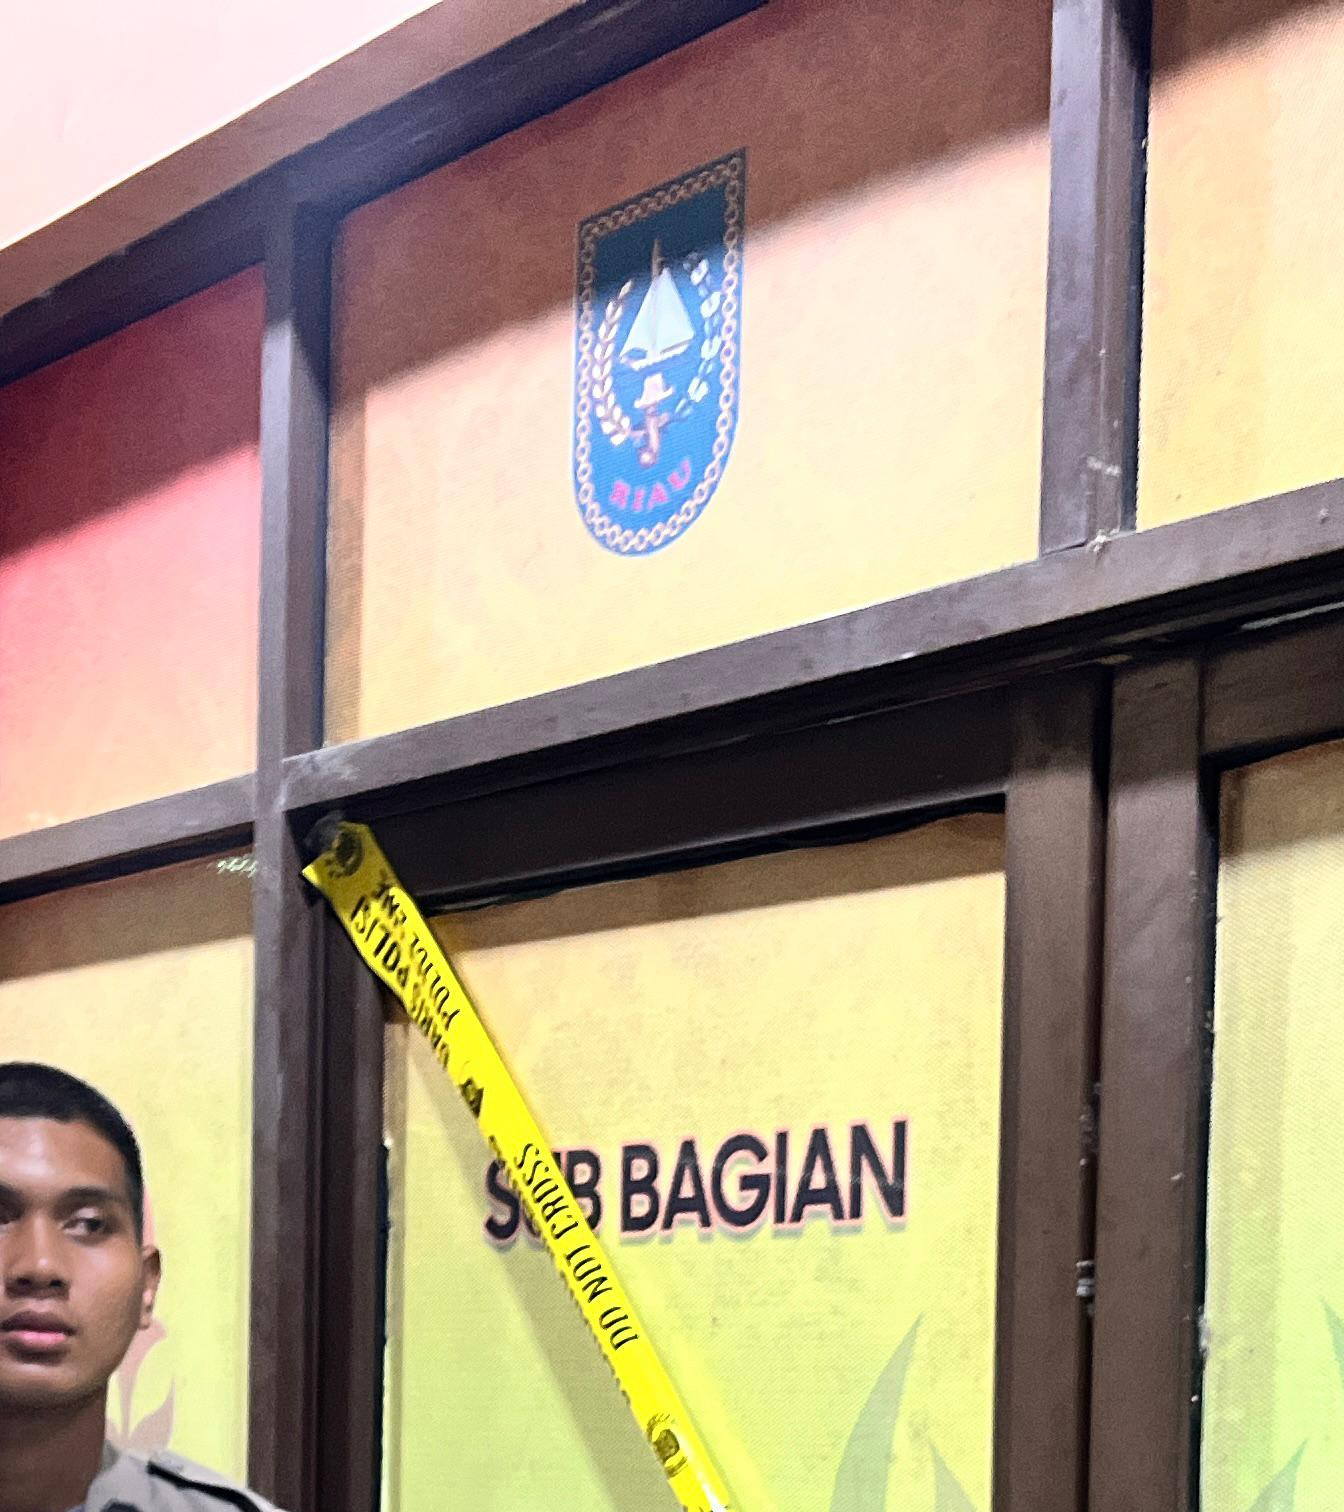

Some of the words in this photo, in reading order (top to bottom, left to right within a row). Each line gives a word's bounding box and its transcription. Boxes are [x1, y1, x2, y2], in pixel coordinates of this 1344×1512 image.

[610, 460, 693, 513] RIAU
[484, 1148, 603, 1241] SB
[620, 1119, 908, 1233] BAGIAN
